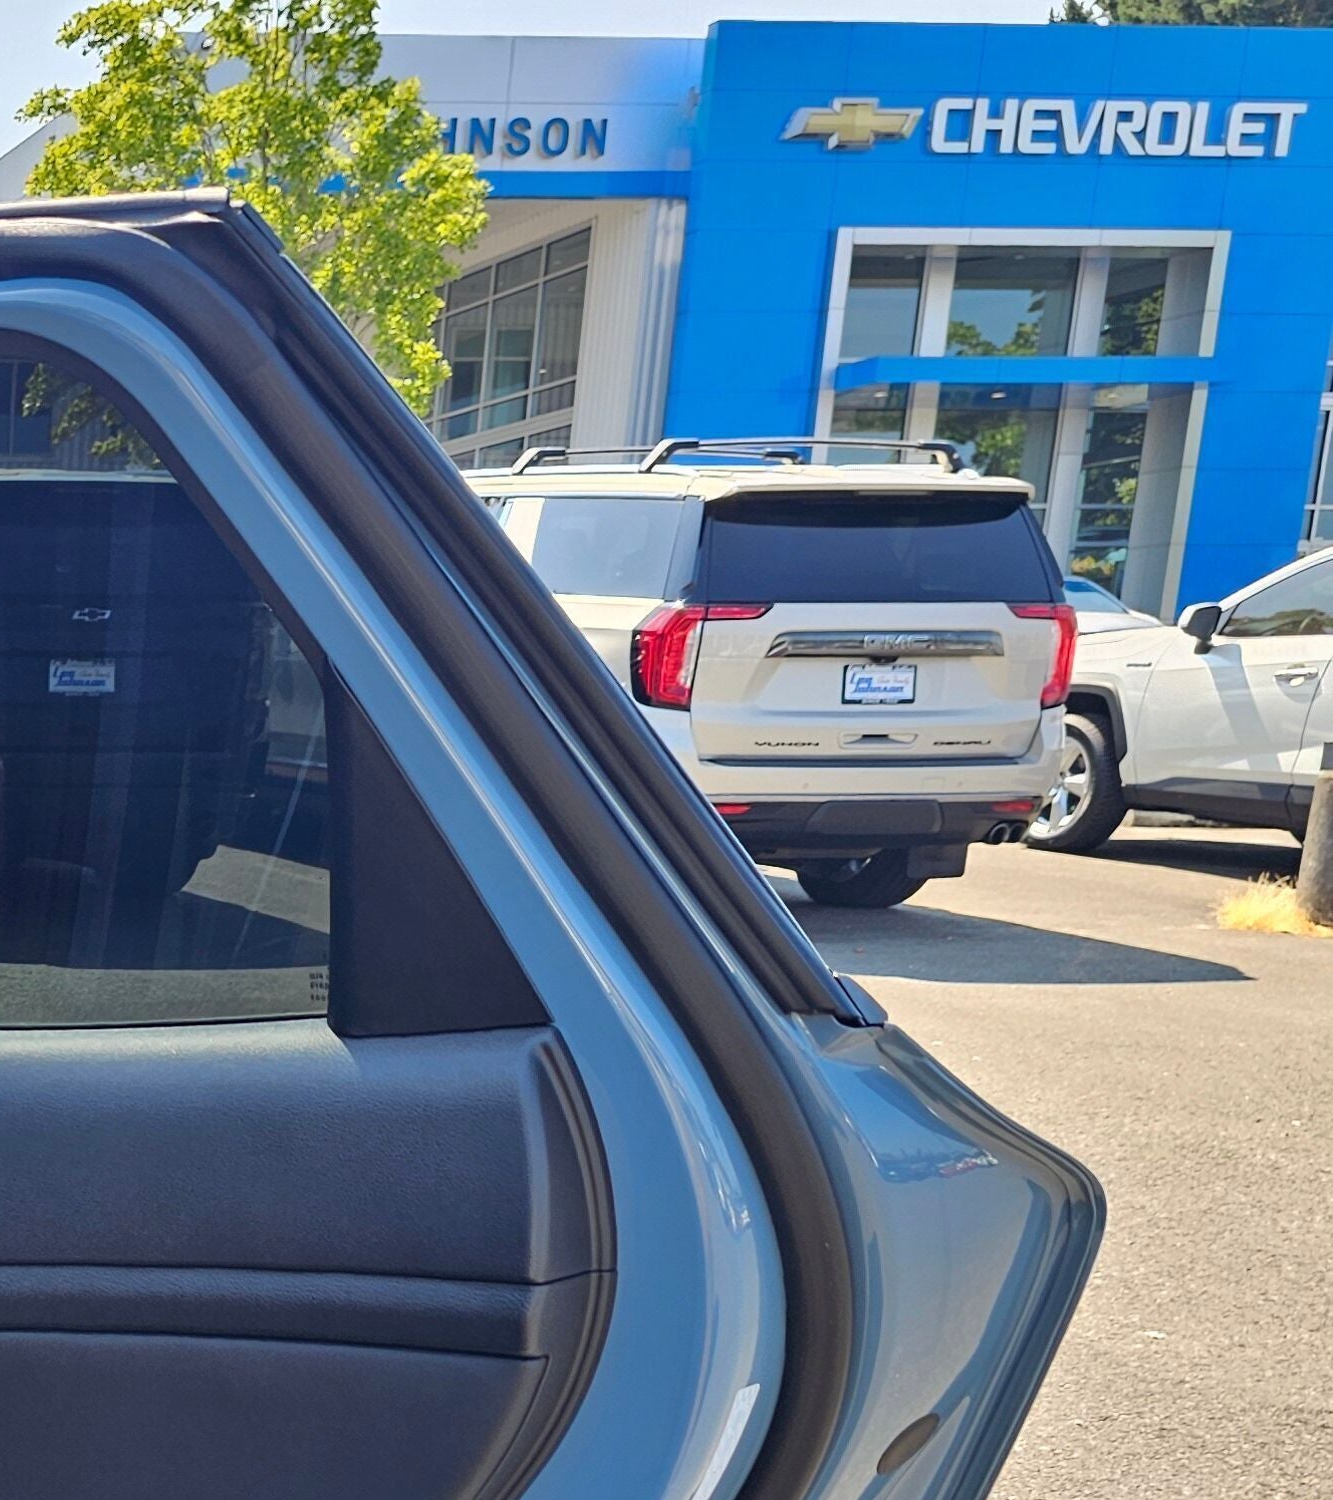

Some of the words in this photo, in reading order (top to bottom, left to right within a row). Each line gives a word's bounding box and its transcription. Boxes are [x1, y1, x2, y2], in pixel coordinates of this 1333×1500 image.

[440, 117, 608, 157] HNSON
[930, 98, 1309, 158] CHEVROLET
[863, 634, 934, 651] GMC
